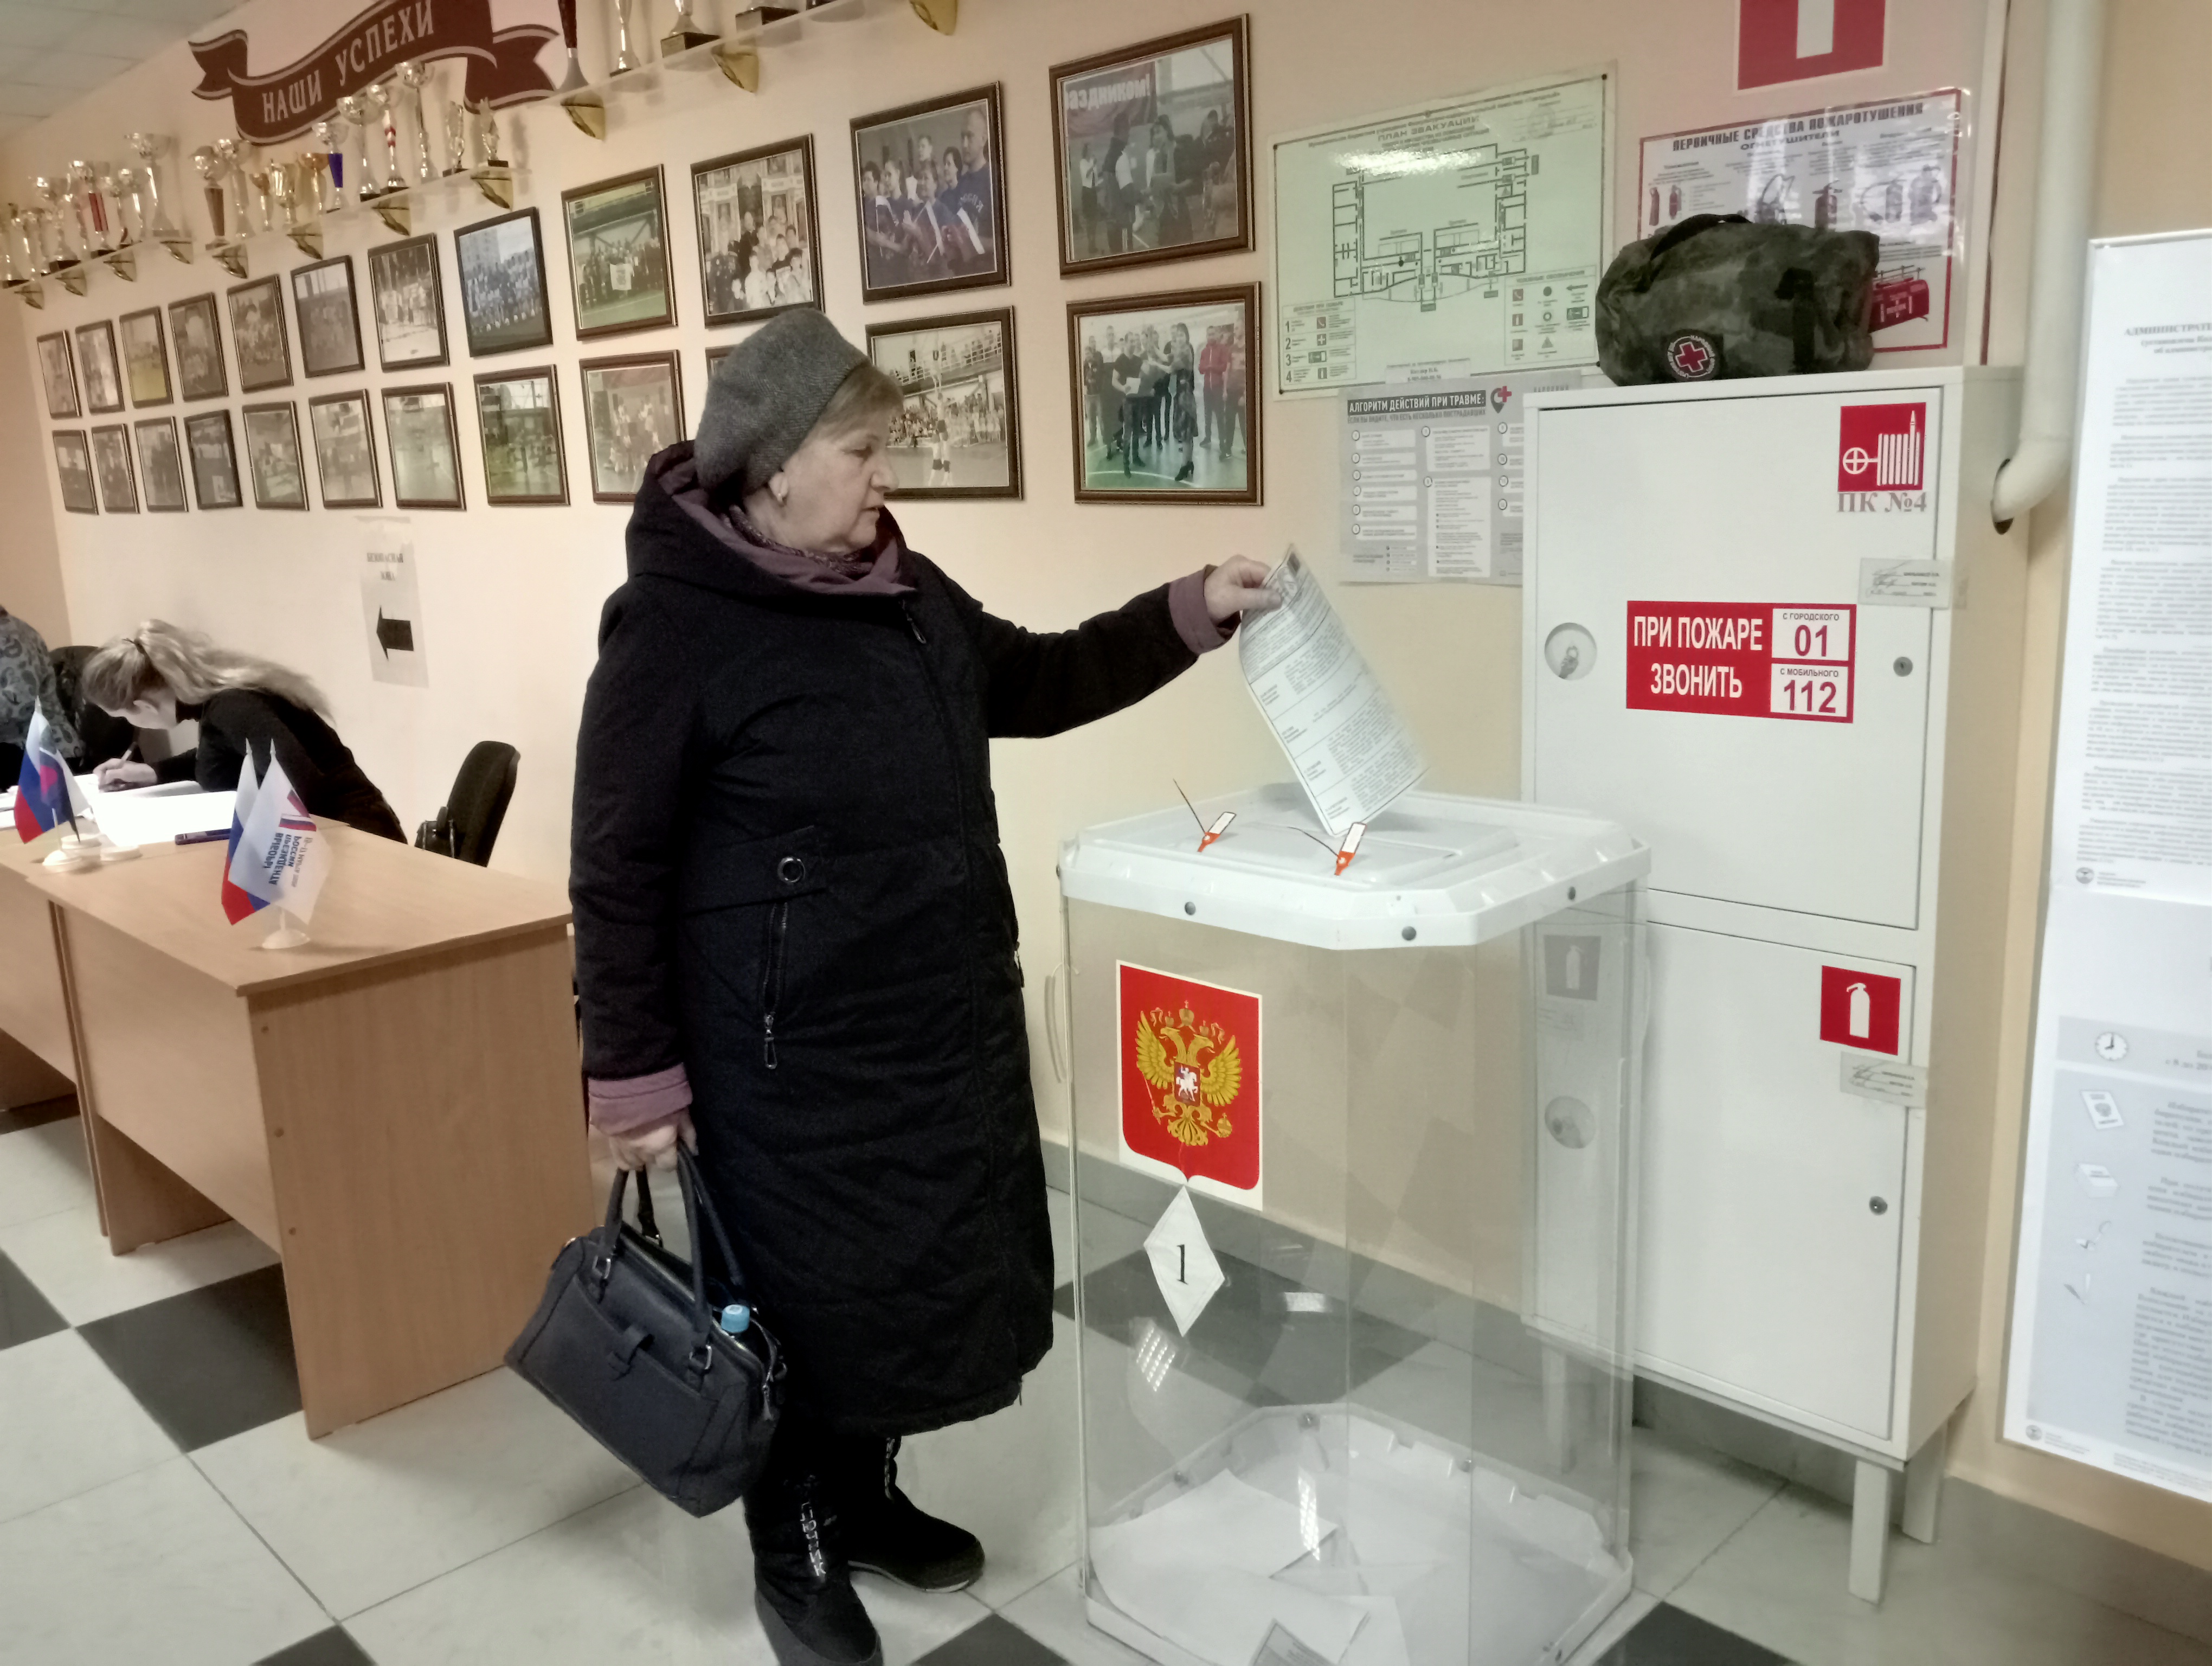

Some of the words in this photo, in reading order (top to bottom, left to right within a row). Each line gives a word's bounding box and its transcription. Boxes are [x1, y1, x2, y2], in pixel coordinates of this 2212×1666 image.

[262, 69, 323, 123] НАШИ
[335, 0, 434, 85] УСПЕХИ
[1378, 131, 1407, 142] ПЛАН
[1411, 116, 1480, 135] ЭВАКУАЦИИ
[1673, 131, 1739, 152] ПЕРВИЧНЫЕ
[1349, 400, 1388, 413] АЛГОРИТМ
[1389, 395, 1430, 412] ДЕЙСТВИЙ
[1431, 396, 1448, 407] ПРИ
[1837, 492, 1878, 512] ПК
[1884, 491, 1927, 512] №4
[1789, 613, 1840, 621] ГОРОДСКОГО
[1634, 616, 1671, 648] ПРИ
[1678, 616, 1763, 651] ПОЖАРЕ
[1793, 625, 1828, 657] 01
[1650, 663, 1742, 699] ЗВОНИТЬ
[1787, 668, 1839, 678] МОБИЛЬНОГО
[1783, 680, 1837, 714] 112
[1176, 1244, 1188, 1285] 1
